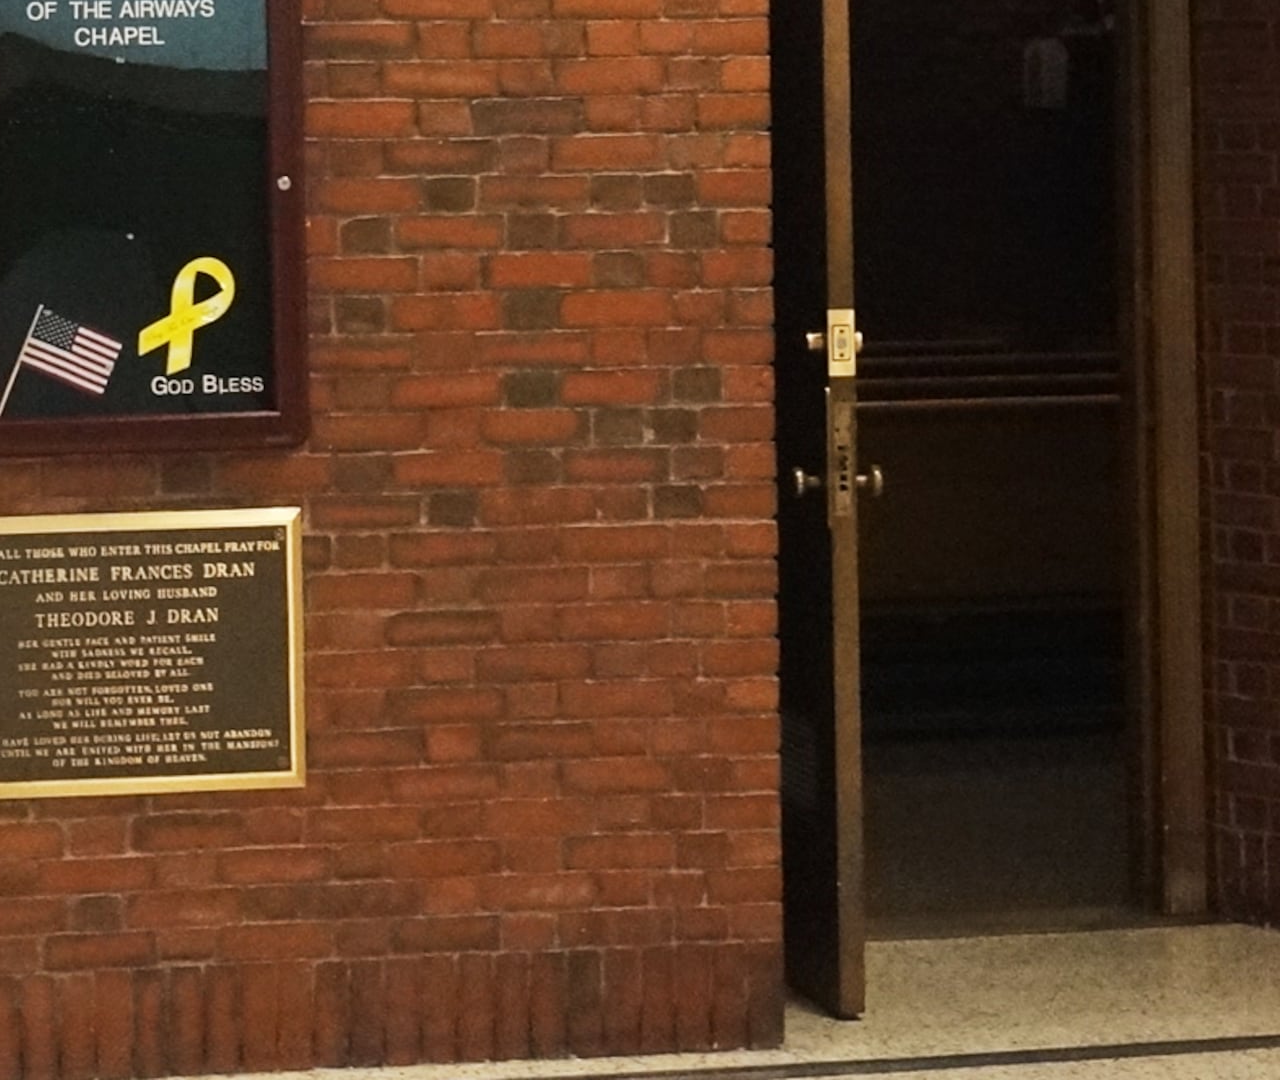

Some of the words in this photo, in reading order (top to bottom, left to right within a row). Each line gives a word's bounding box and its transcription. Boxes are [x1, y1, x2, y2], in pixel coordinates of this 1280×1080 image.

[26, 1, 57, 20] OF
[70, 0, 112, 20] THE
[120, 0, 215, 18] AIRWAYS
[74, 27, 165, 47] CHAPEL
[25, 547, 64, 558] THOSE
[69, 546, 97, 557] WHO
[101, 546, 141, 556] ENTER
[145, 544, 173, 555] THIS
[175, 543, 222, 554] CHAPEL
[225, 542, 256, 553] PRAY
[257, 540, 280, 551] FOR
[111, 563, 193, 581] FRANCES
[203, 562, 255, 578] DRAN
[35, 592, 64, 603] AND
[70, 591, 96, 601] HER
[102, 589, 151, 600] LOVING
[157, 587, 217, 599] HUSBAND
[35, 610, 134, 628] THEODORE
[168, 608, 219, 624] DRAN
